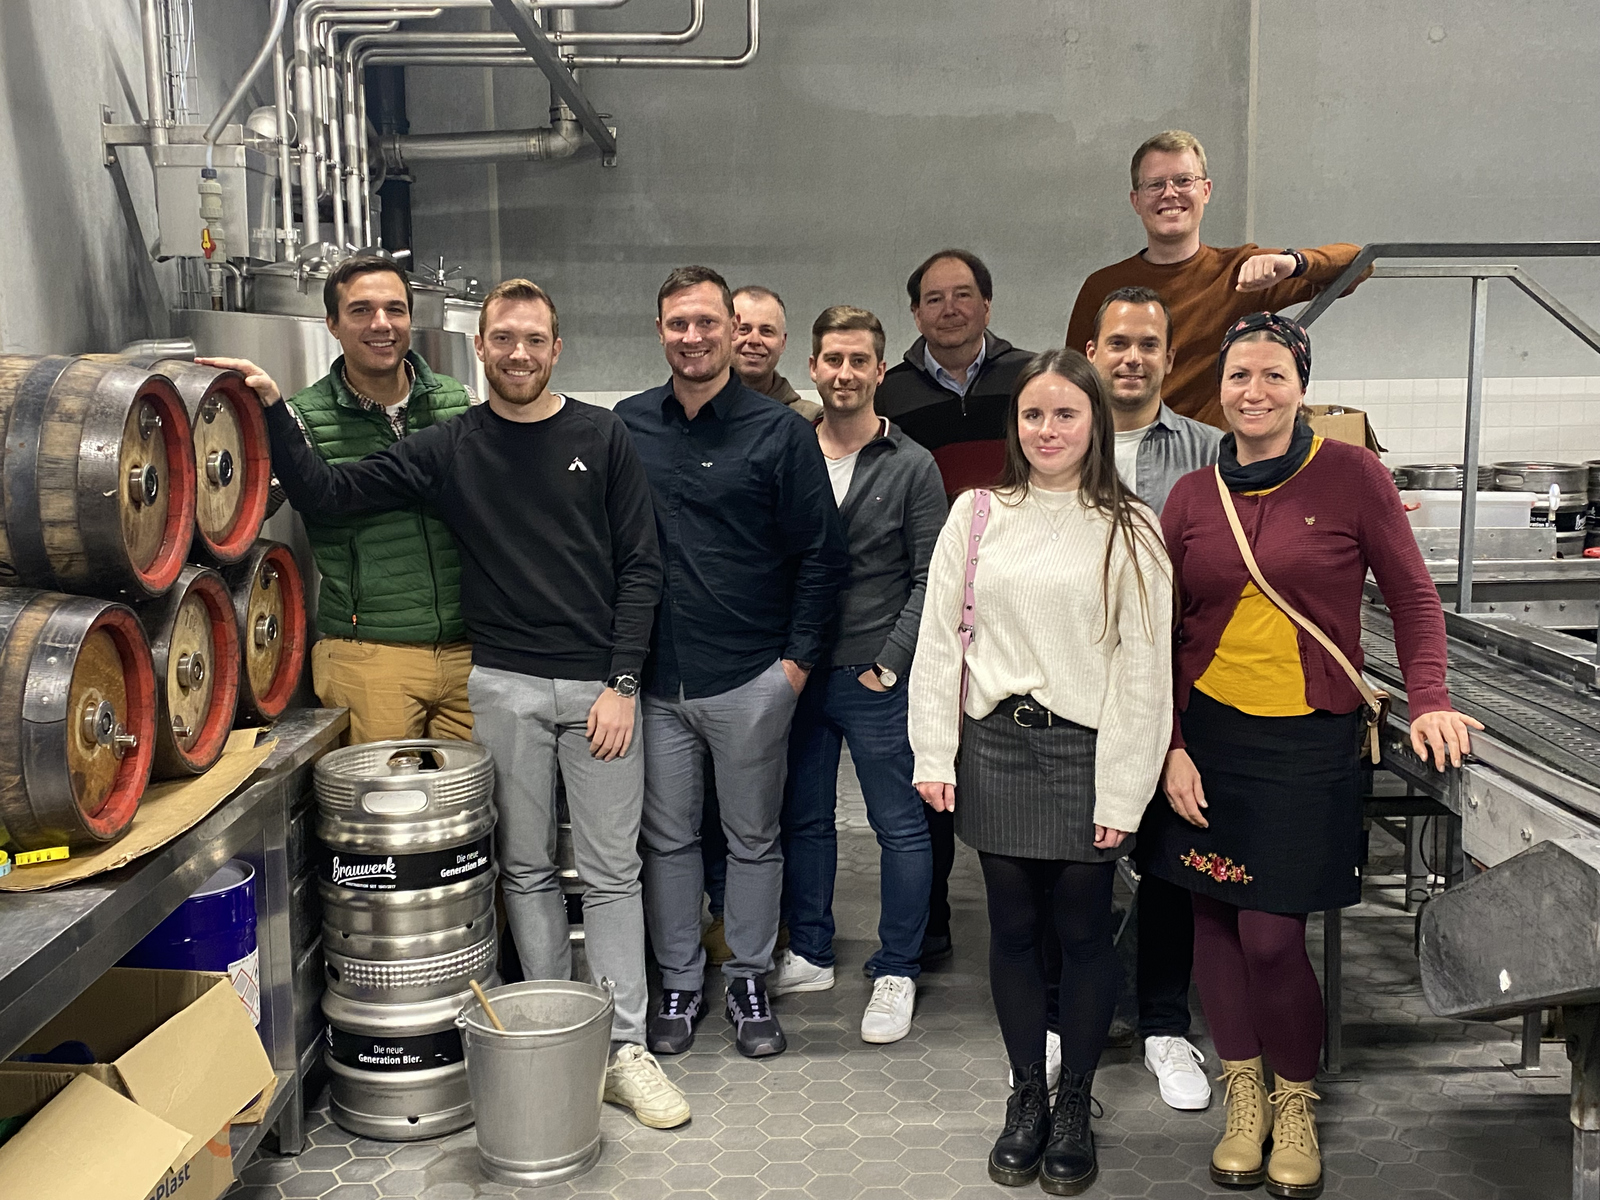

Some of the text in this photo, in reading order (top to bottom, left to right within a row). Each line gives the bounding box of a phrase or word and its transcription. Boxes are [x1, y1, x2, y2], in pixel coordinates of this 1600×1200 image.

[456, 854, 466, 864] Die
[332, 856, 396, 882] Brauwerk
[440, 862, 477, 878] Generation
[373, 1044, 404, 1055] Die neue
[358, 1053, 423, 1065] Generation Bier.
[150, 1163, 190, 1200] Plast
